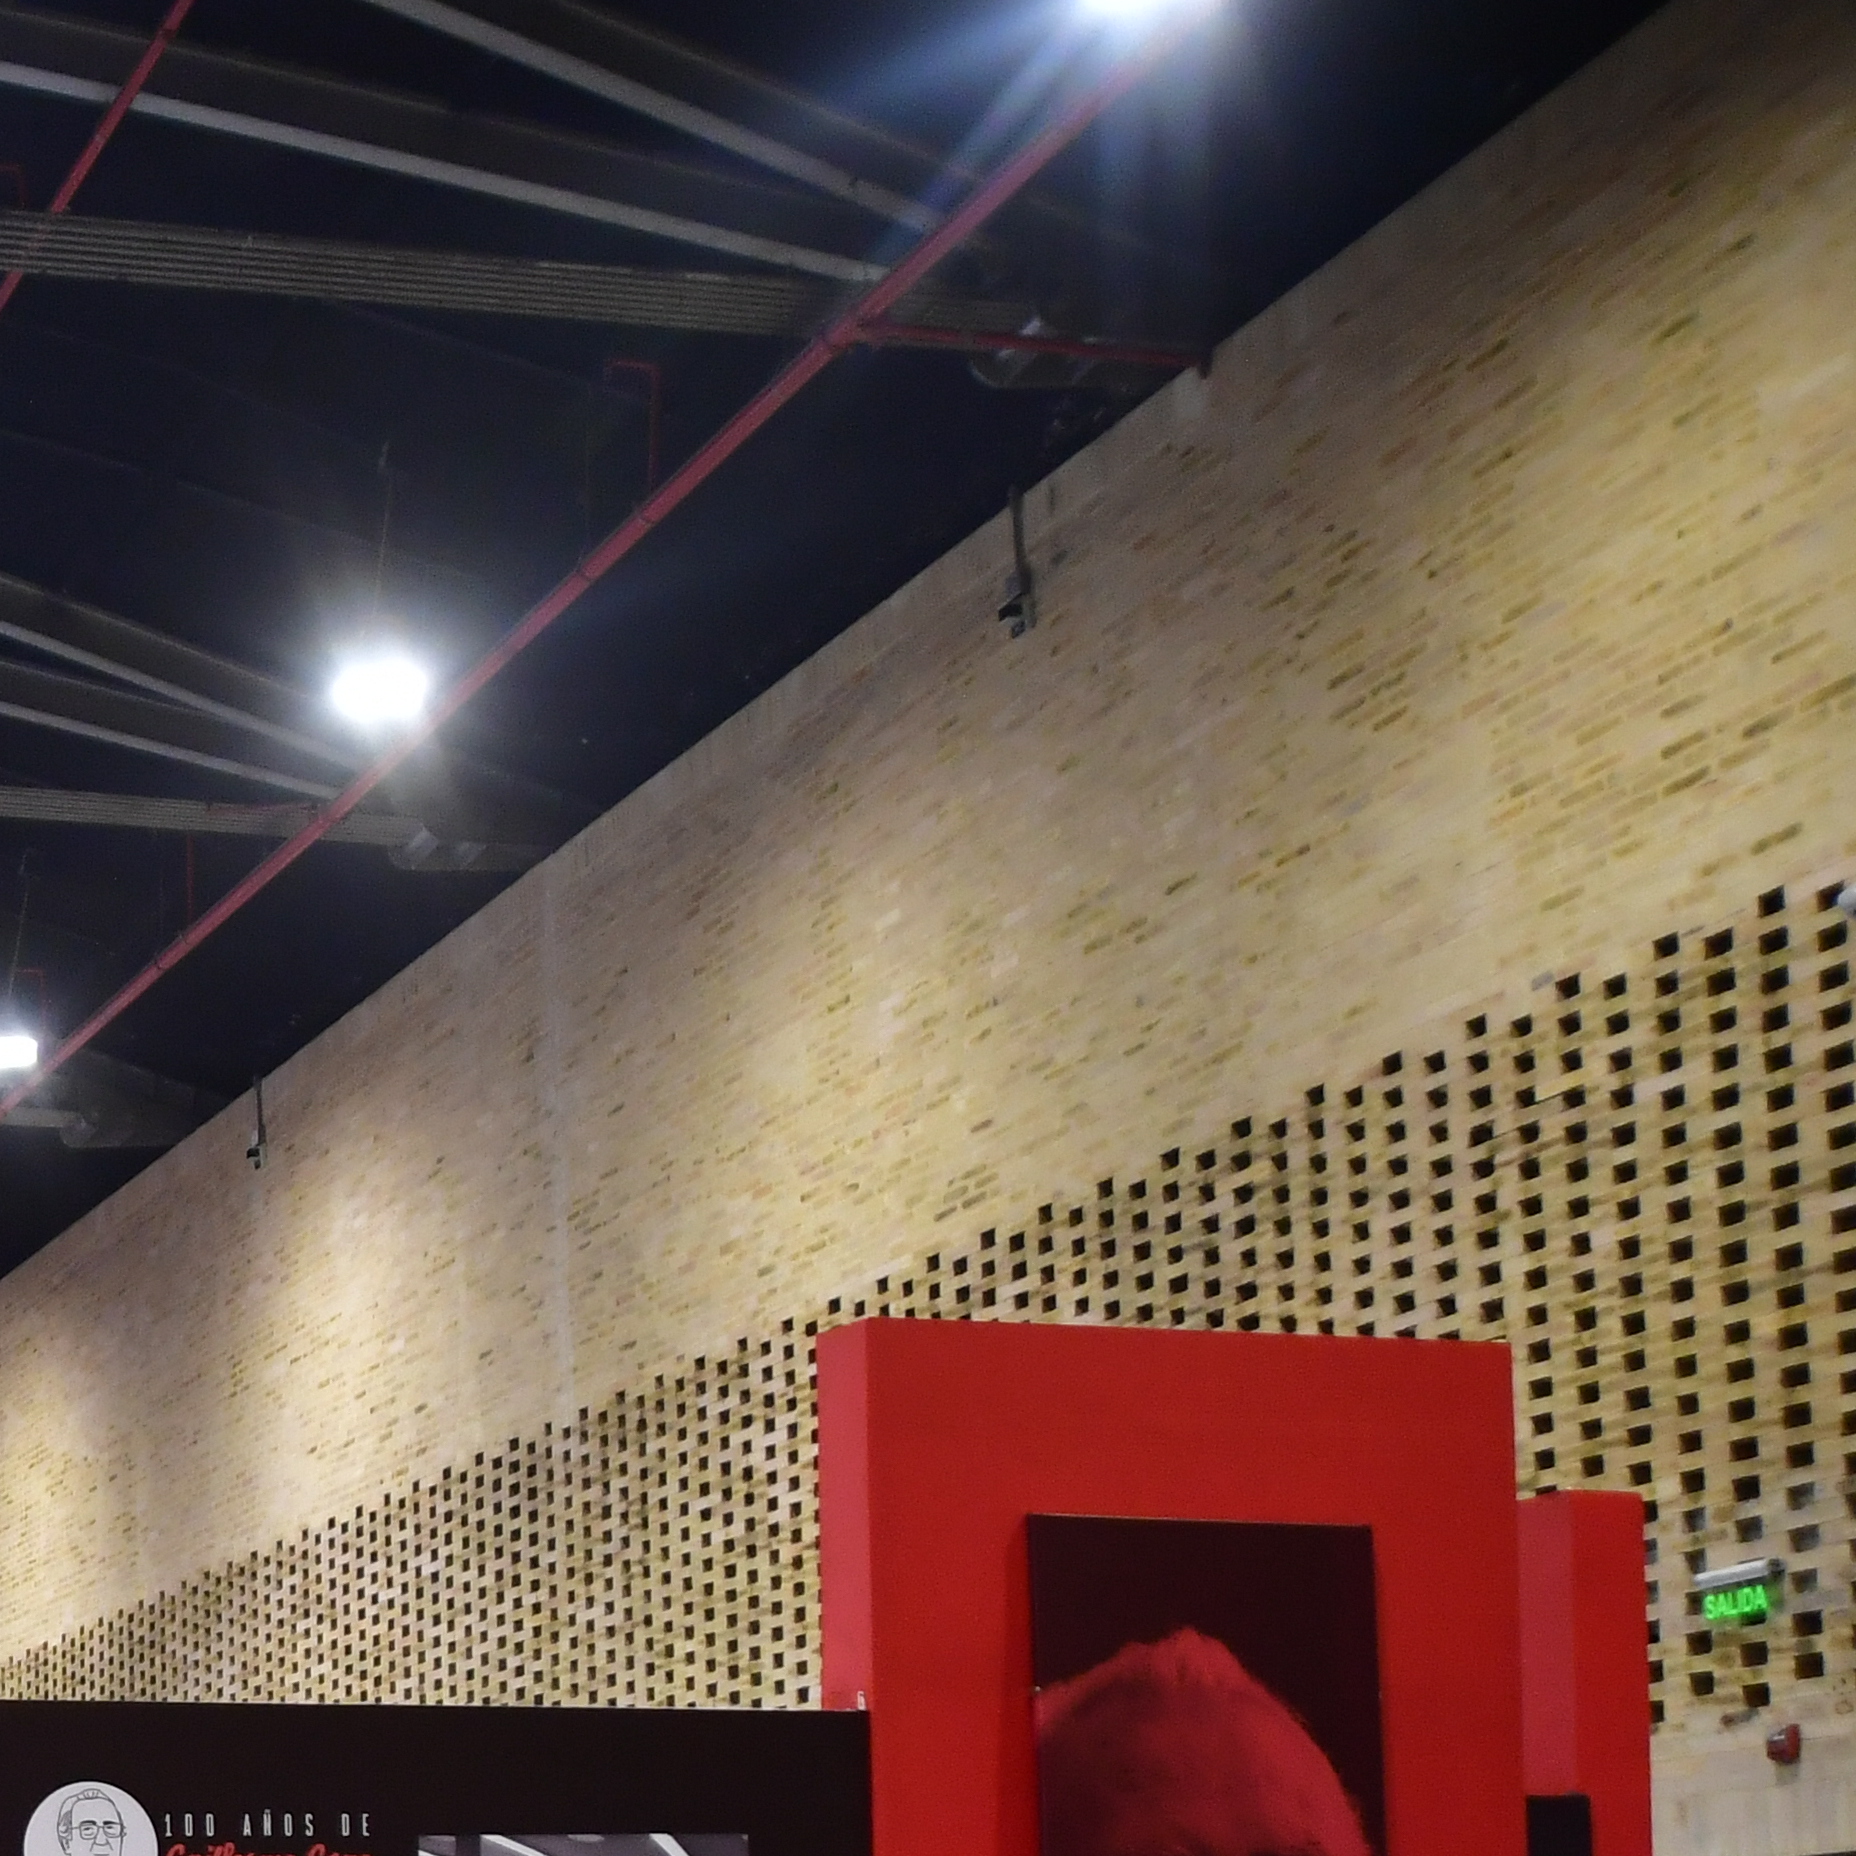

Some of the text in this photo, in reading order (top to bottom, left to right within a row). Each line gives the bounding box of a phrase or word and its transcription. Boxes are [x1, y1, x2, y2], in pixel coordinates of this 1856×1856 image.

[1703, 1584, 1768, 1621] SALIDA
[165, 1809, 370, 1837] 100 AÑOS DE
